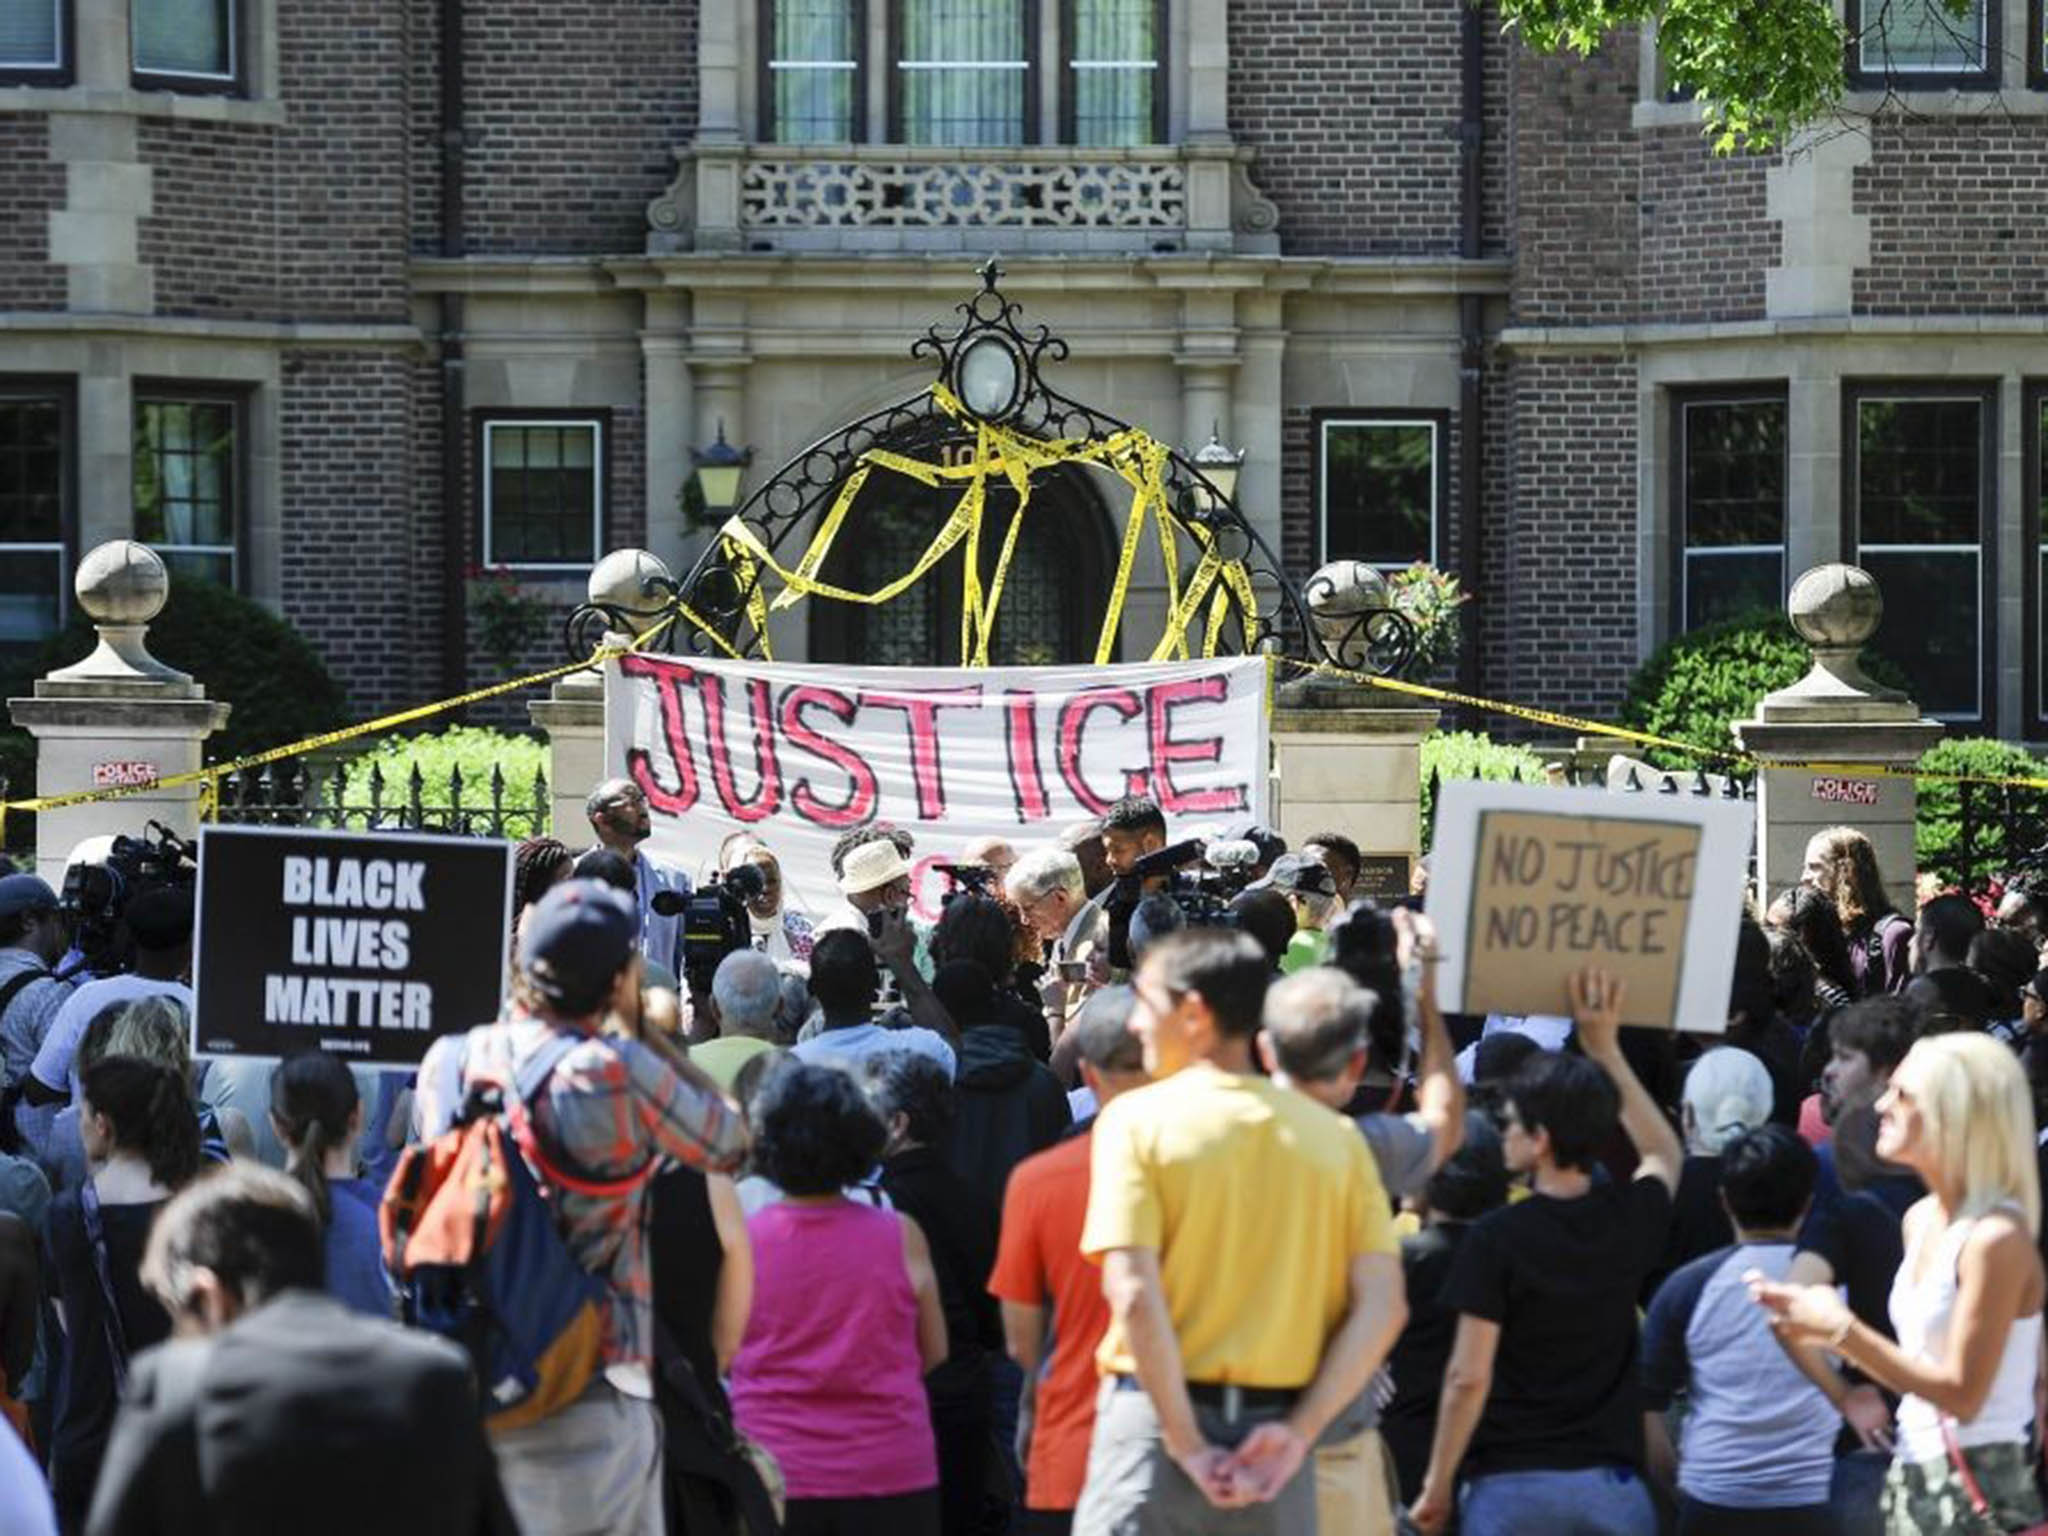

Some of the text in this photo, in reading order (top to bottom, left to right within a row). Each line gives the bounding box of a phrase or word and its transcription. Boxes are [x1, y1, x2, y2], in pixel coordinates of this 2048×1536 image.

[620, 654, 1249, 829] JUSTICE
[94, 762, 157, 777] POLICE
[1813, 779, 1877, 796] POLICE
[282, 856, 427, 911] BLACK
[1490, 834, 1698, 901] NO JUSTICE
[292, 916, 411, 970] LIVES
[1485, 902, 1668, 955] NO PEACE
[265, 975, 434, 1030] MATTER
